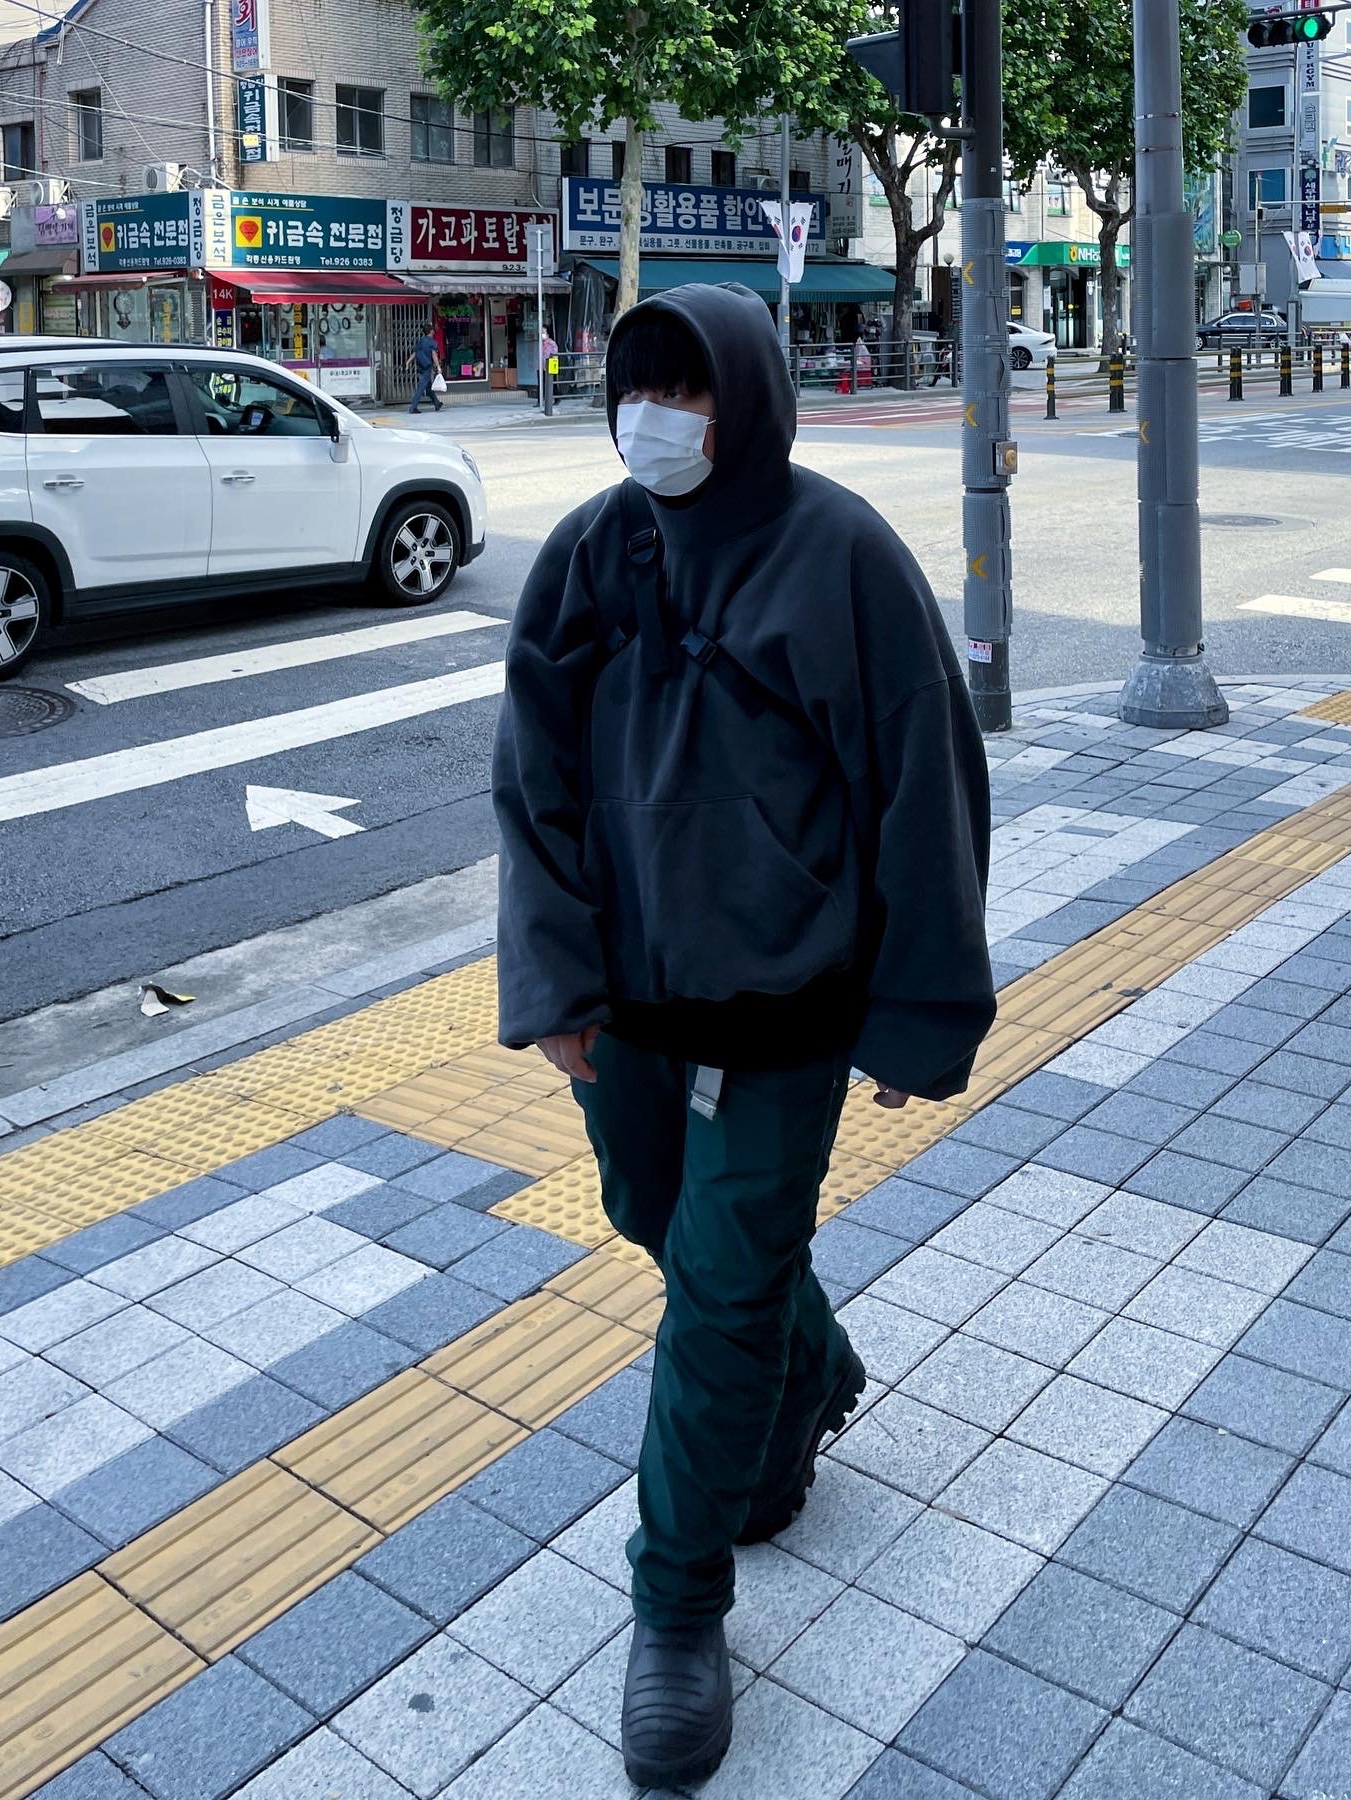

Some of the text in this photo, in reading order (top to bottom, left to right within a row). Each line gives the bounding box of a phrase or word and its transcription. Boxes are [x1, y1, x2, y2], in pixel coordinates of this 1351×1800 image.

[243, 89, 262, 160] 귀금속전점
[117, 218, 189, 249] 귀금속 전문점
[193, 197, 203, 260] 정금당
[212, 195, 226, 262] 금은보석
[266, 219, 382, 250] 귀금속 전문점
[390, 207, 404, 264] 정금당
[320, 257, 373, 266] Tel.926 0383
[213, 289, 233, 300] 14K
